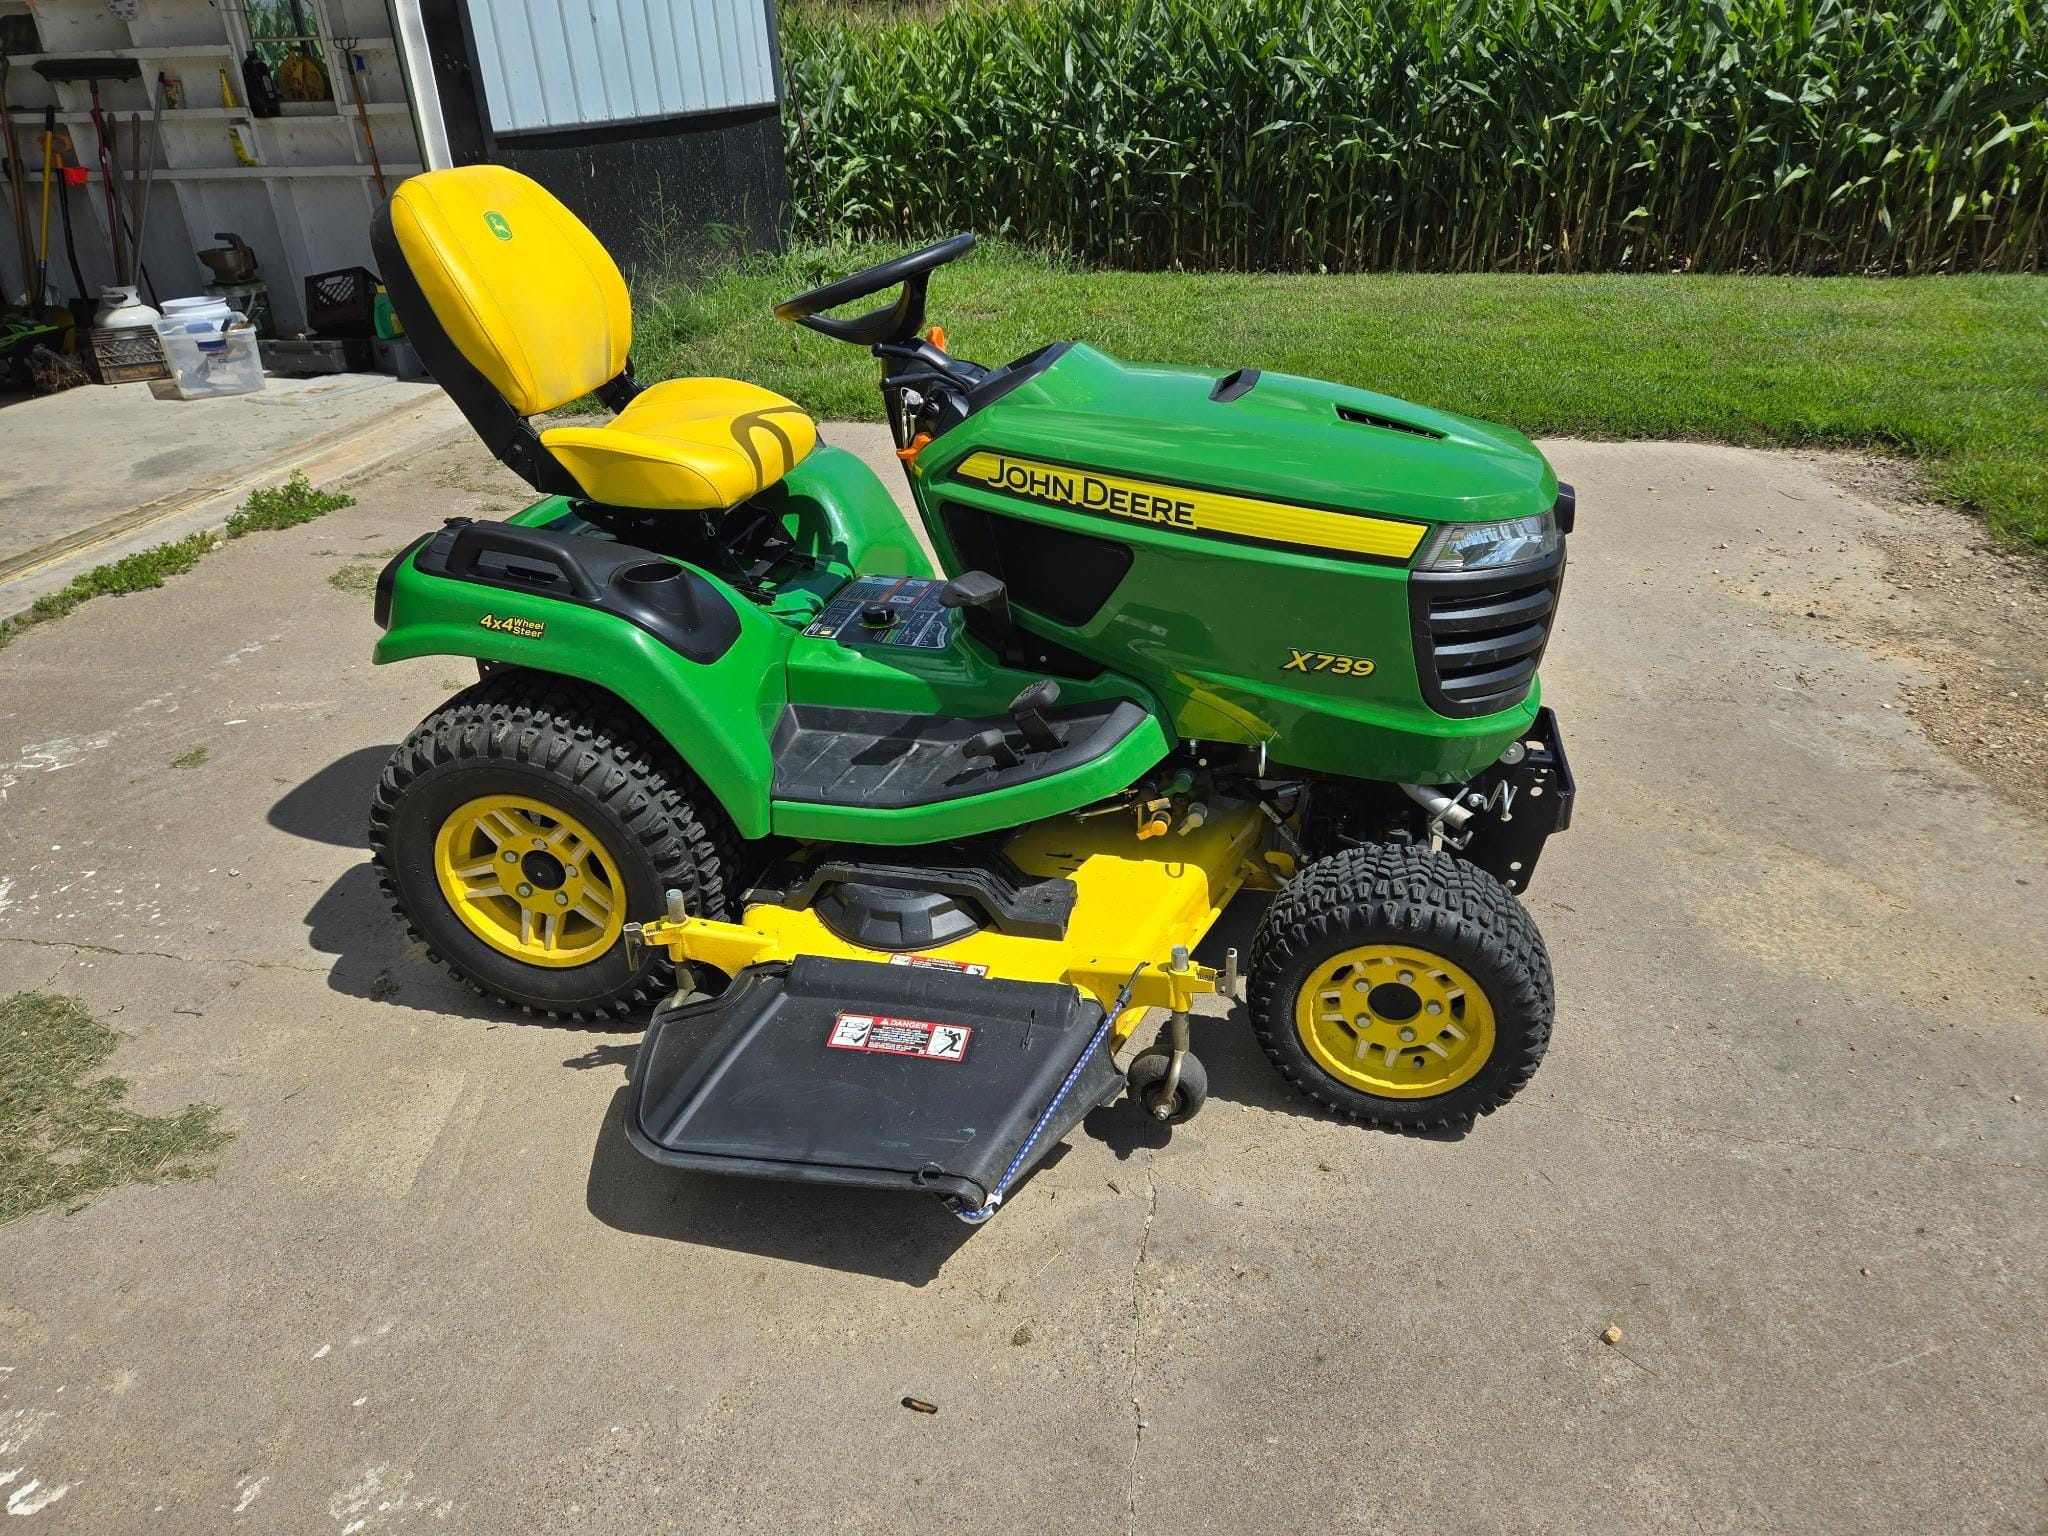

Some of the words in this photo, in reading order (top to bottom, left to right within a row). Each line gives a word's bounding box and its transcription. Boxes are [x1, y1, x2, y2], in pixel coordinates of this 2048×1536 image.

[987, 458, 1074, 501] JOHN
[1083, 476, 1196, 527] DEERE
[480, 614, 513, 632] 4x4
[514, 617, 544, 630] Wheel
[512, 626, 543, 638] Steer
[1282, 649, 1376, 677] X739
[890, 1019, 929, 1030] DANGER
